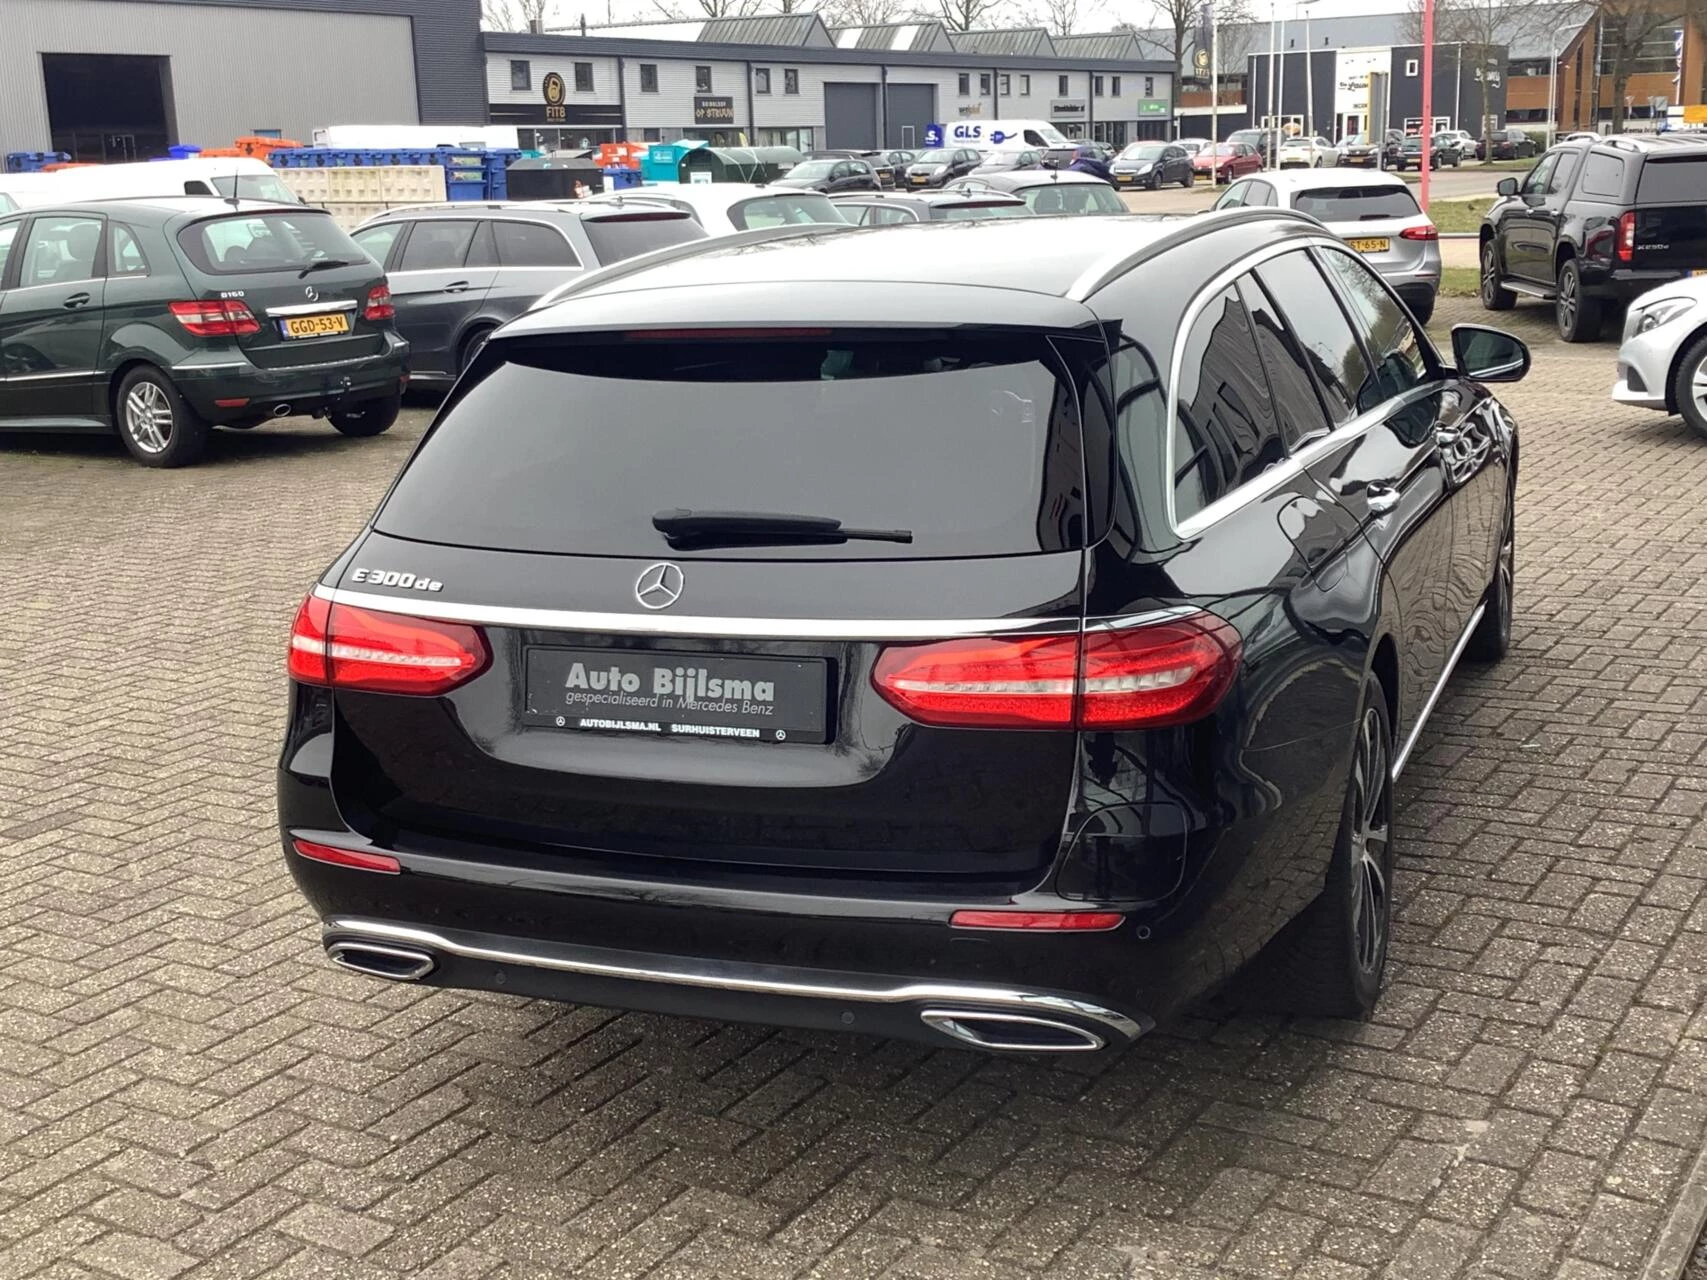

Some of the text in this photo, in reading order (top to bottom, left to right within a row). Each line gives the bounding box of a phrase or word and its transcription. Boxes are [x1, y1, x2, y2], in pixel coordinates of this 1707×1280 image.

[290, 315, 344, 334] GGD-53-V
[565, 662, 775, 703] Auto Bijlsma
[566, 690, 774, 716] gespecialiseerd in Mercedes Benz
[580, 718, 761, 738] AUTOBIJLSMA.NL SURHUISTERVEEN
